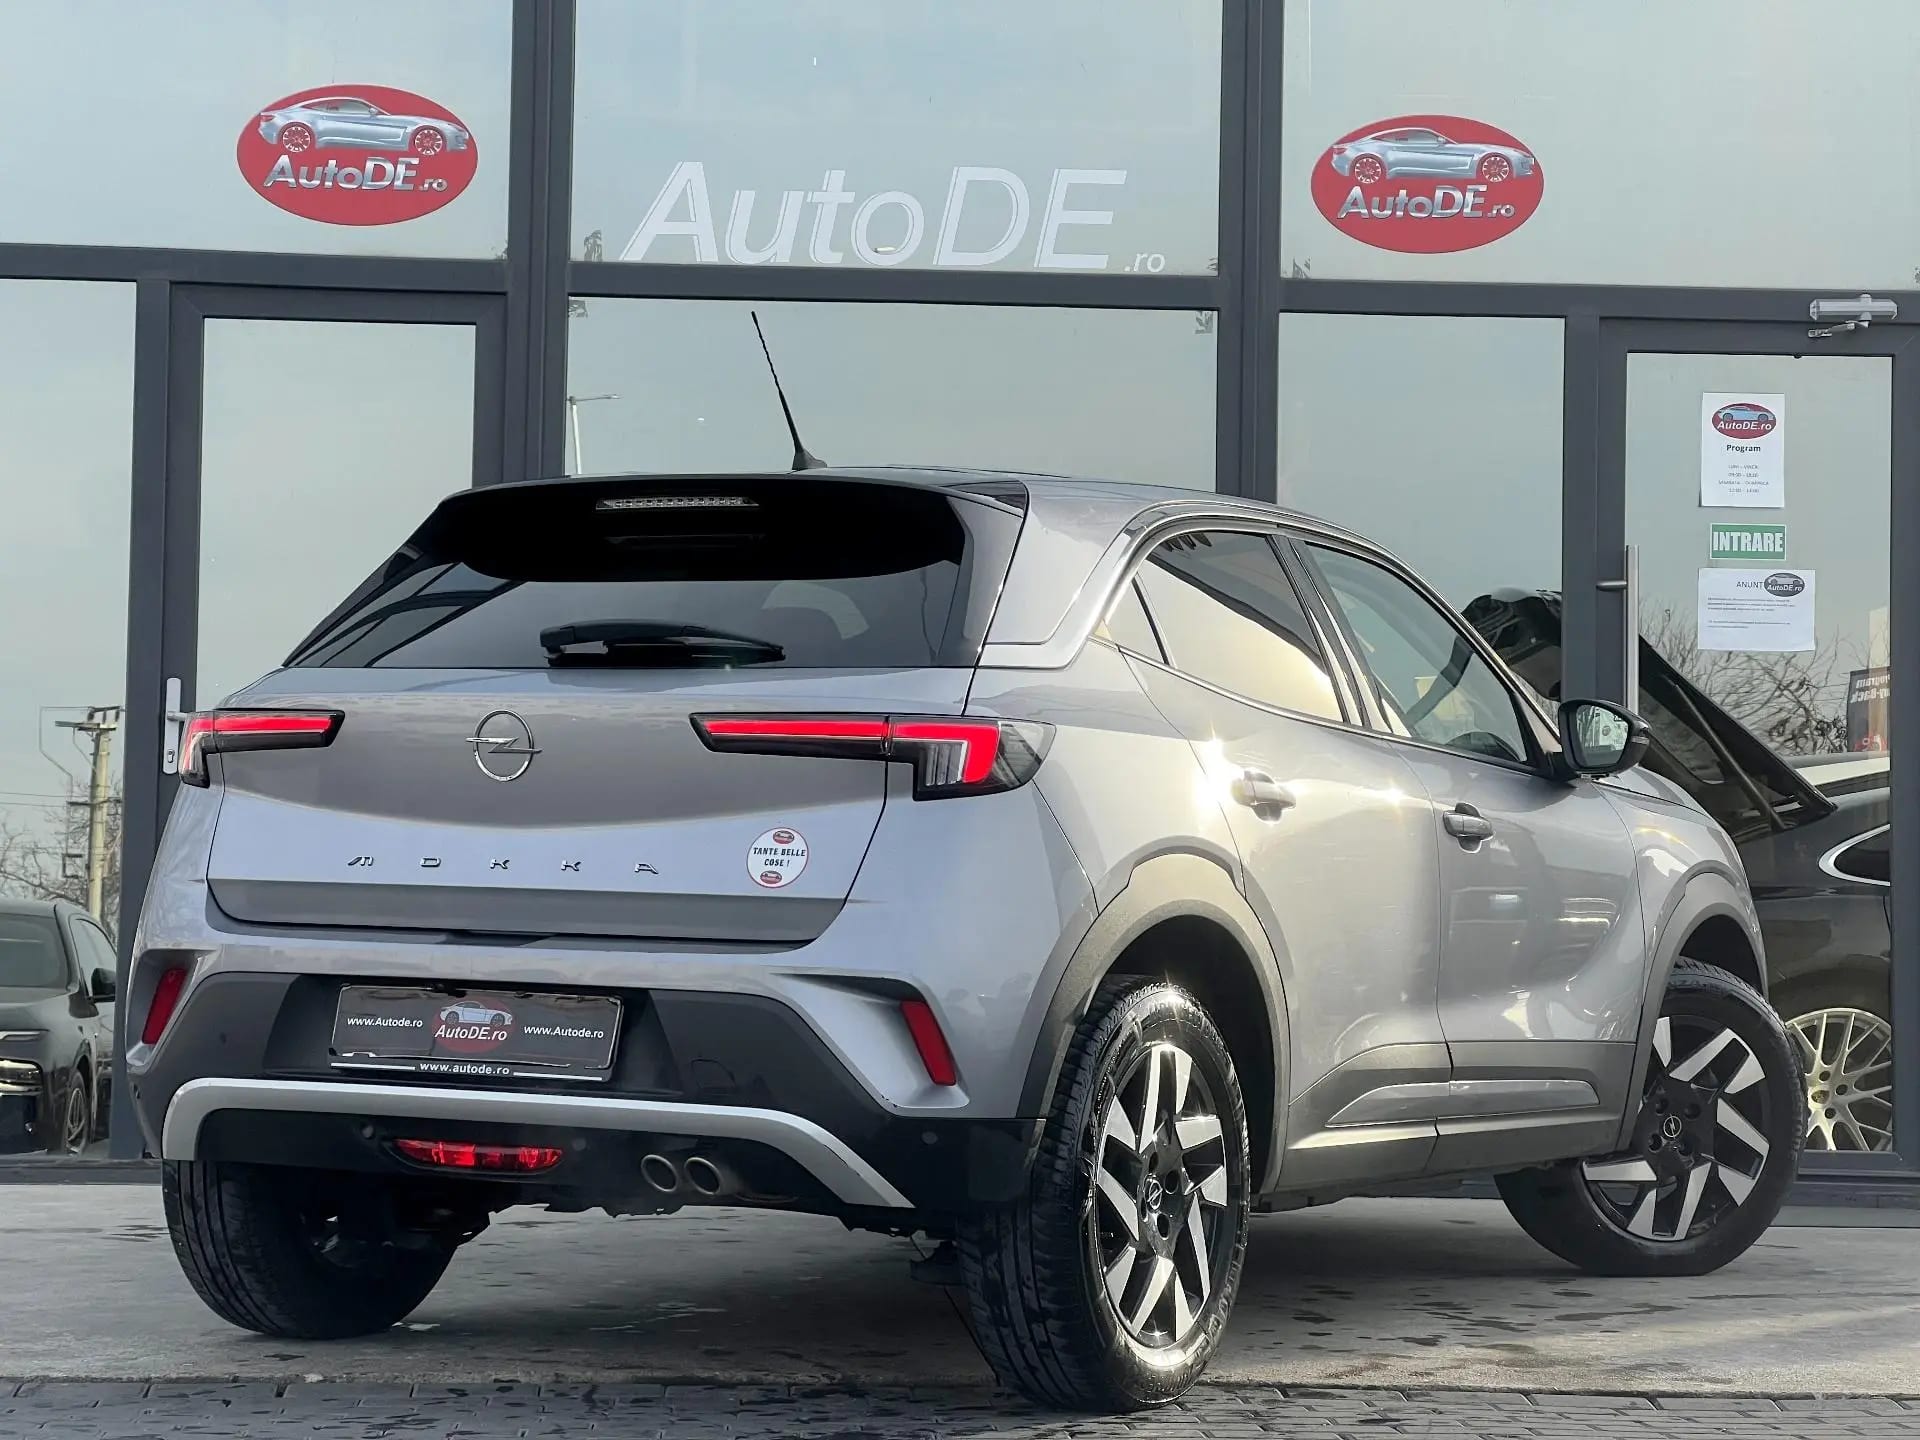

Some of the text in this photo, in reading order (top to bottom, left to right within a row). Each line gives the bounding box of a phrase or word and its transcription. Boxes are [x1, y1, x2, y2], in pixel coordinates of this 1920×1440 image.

[1716, 420, 1772, 431] AutoDE.ro
[1726, 444, 1761, 454] Program
[1712, 531, 1784, 553] INTRARE
[753, 847, 806, 857] TANTE BELLE
[348, 856, 659, 876] MOKKA
[346, 1016, 424, 1029] www.Autode.ro
[434, 1024, 508, 1042] AutoDE.ro
[523, 1025, 605, 1040] www.Autode.ro
[419, 1061, 511, 1076] www.autode.ro
